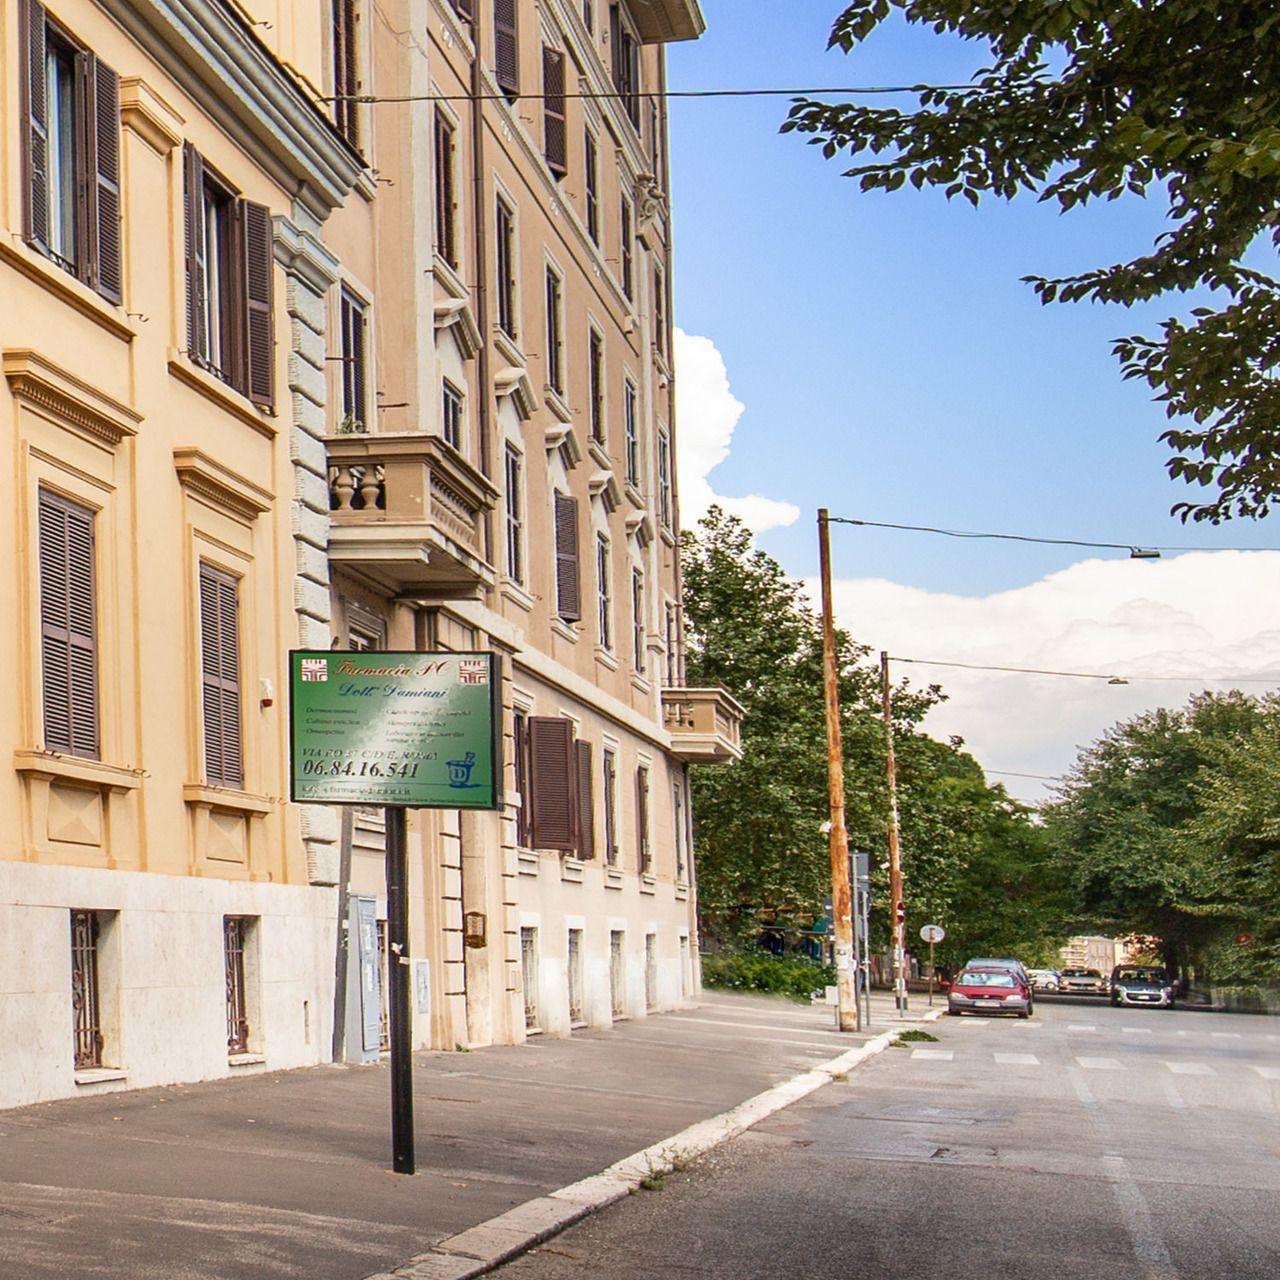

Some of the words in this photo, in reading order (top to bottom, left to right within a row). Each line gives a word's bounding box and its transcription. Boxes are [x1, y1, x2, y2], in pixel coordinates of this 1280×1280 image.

[333, 659, 411, 677] Farmacia
[383, 683, 449, 699] Damiani
[302, 748, 321, 756] VIA
[303, 758, 419, 778] 06.84.16.541
